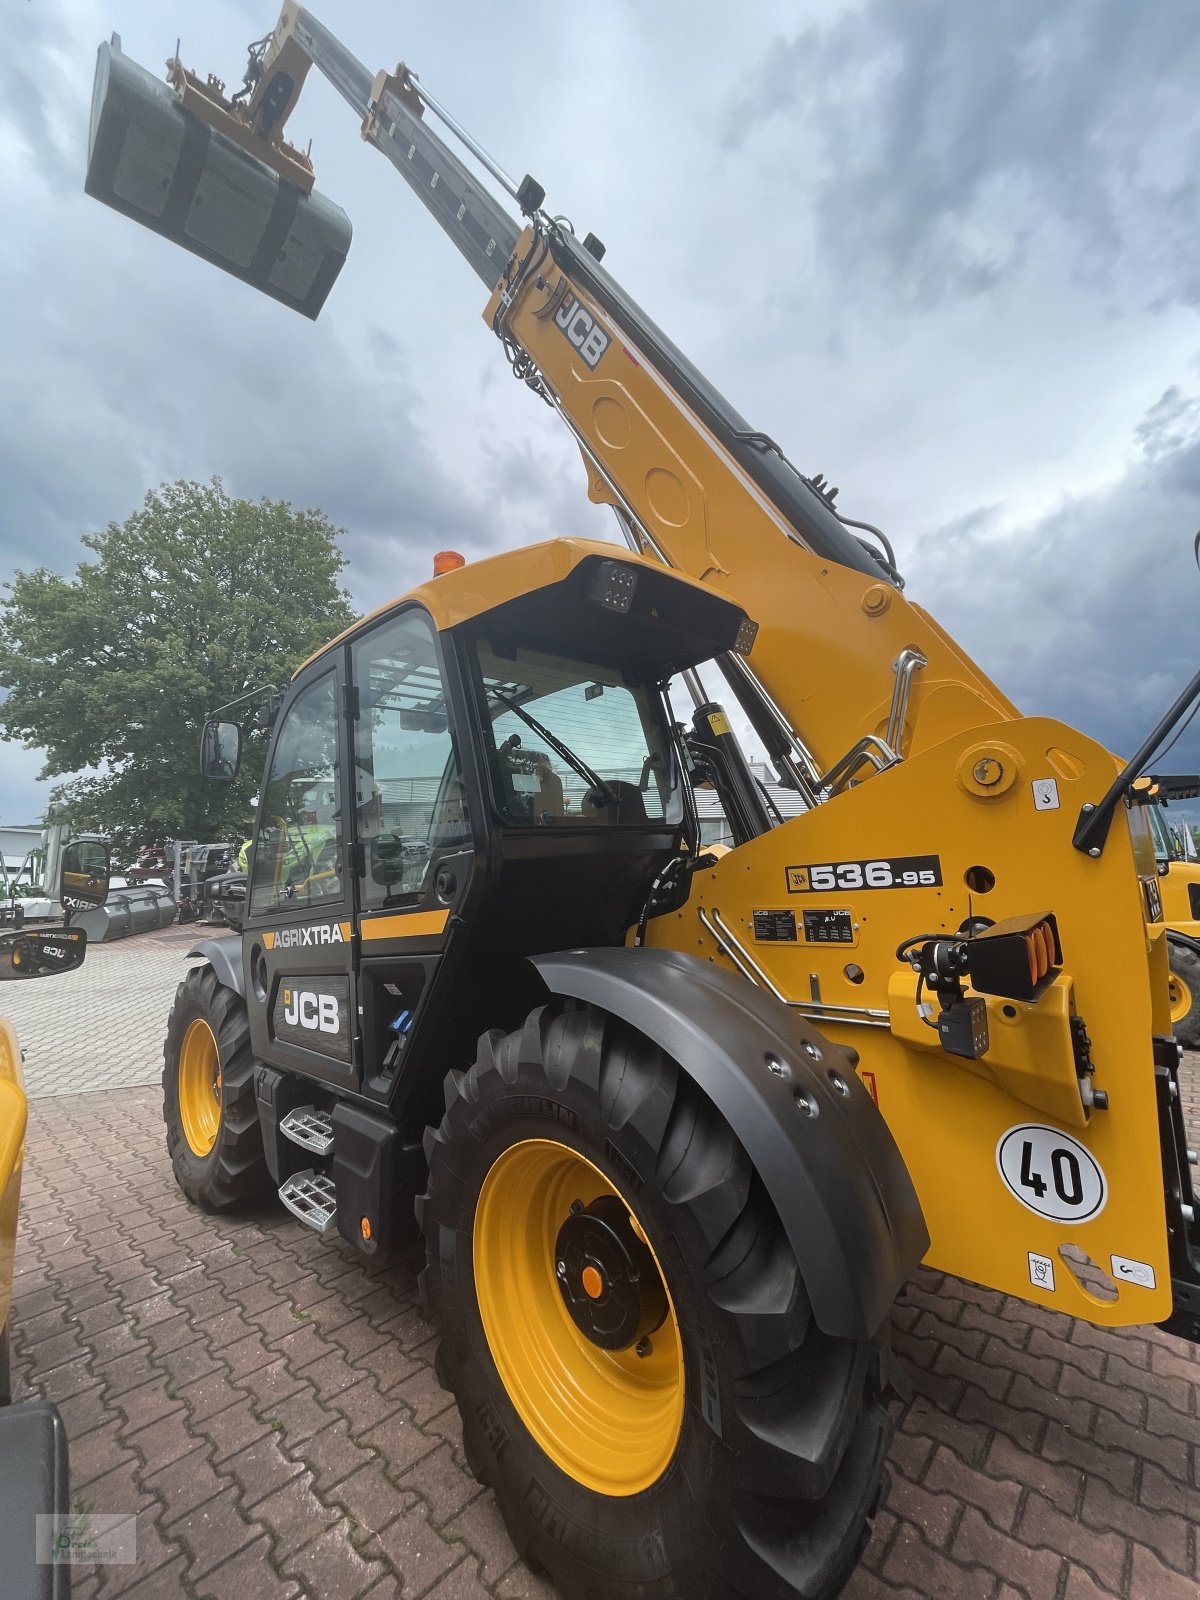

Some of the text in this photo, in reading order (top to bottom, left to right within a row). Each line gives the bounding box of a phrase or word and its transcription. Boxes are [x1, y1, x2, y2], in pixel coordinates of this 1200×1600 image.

[555, 300, 608, 366] JCB
[810, 861, 936, 890] 536-95
[273, 923, 344, 949] AGRIXTRA
[283, 989, 340, 1034] JCB
[1020, 1140, 1084, 1206] 40
